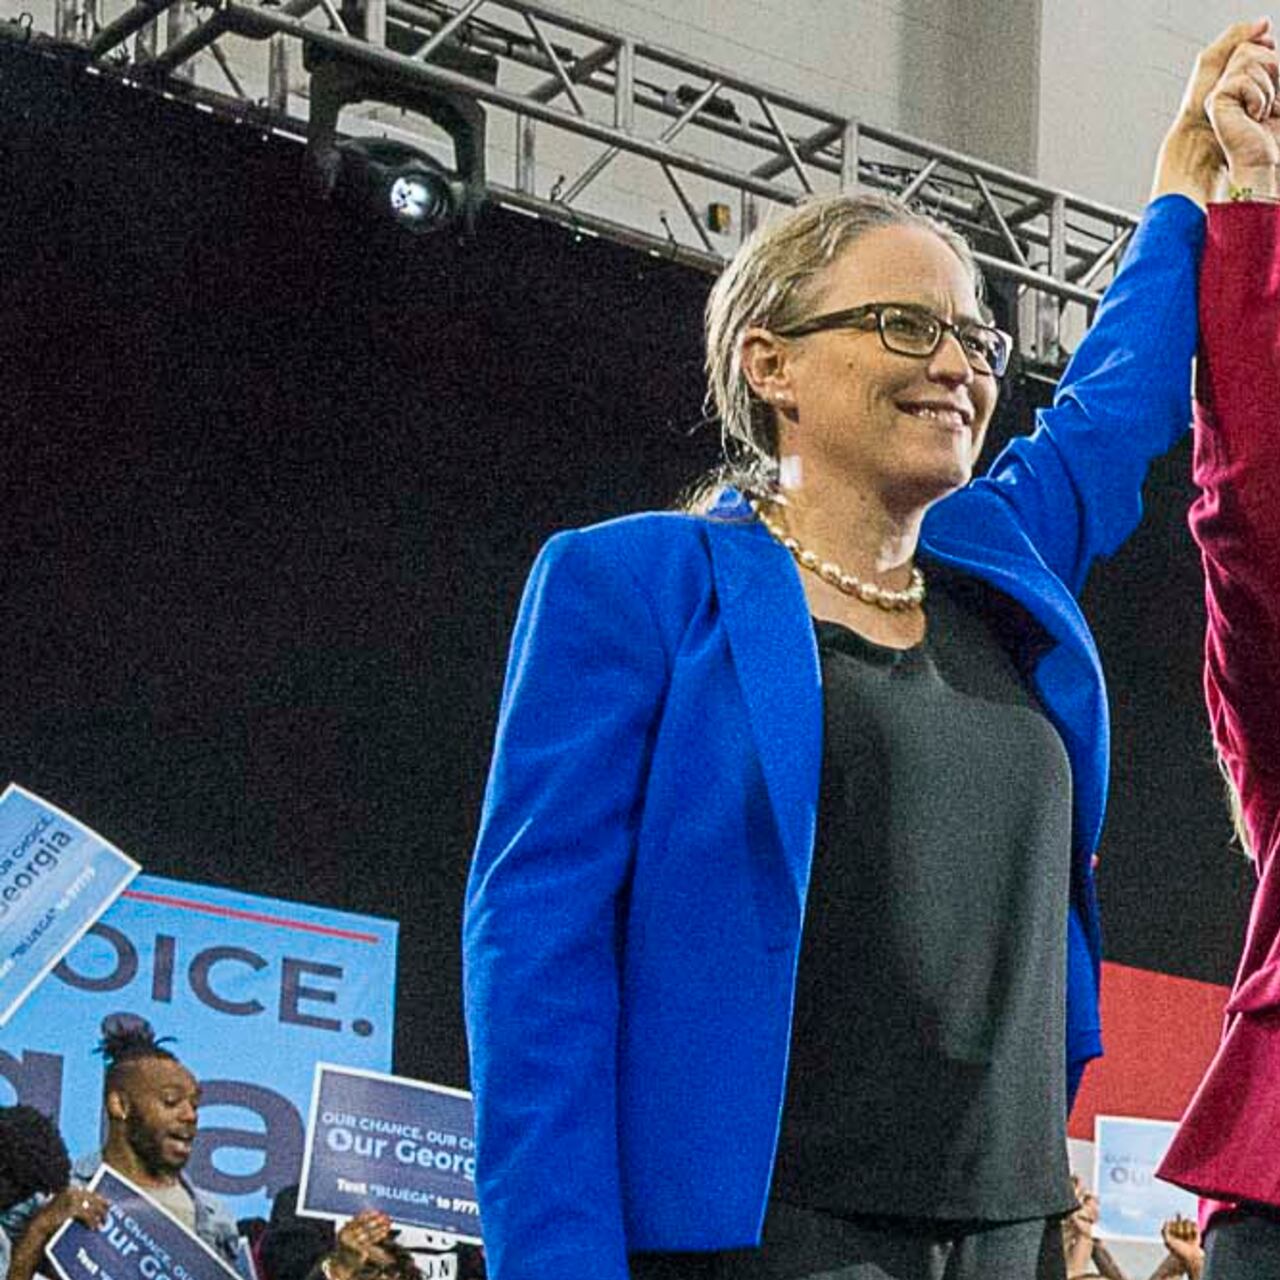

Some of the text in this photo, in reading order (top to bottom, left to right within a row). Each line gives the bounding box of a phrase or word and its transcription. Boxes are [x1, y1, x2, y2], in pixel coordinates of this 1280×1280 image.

[0, 830, 73, 920] eorgia
[321, 1110, 356, 1128] OUR
[426, 1130, 457, 1148] OUR
[326, 1127, 388, 1159] Our
[336, 1178, 368, 1195] Text
[436, 1196, 451, 1211] to
[76, 1247, 99, 1275] Text
